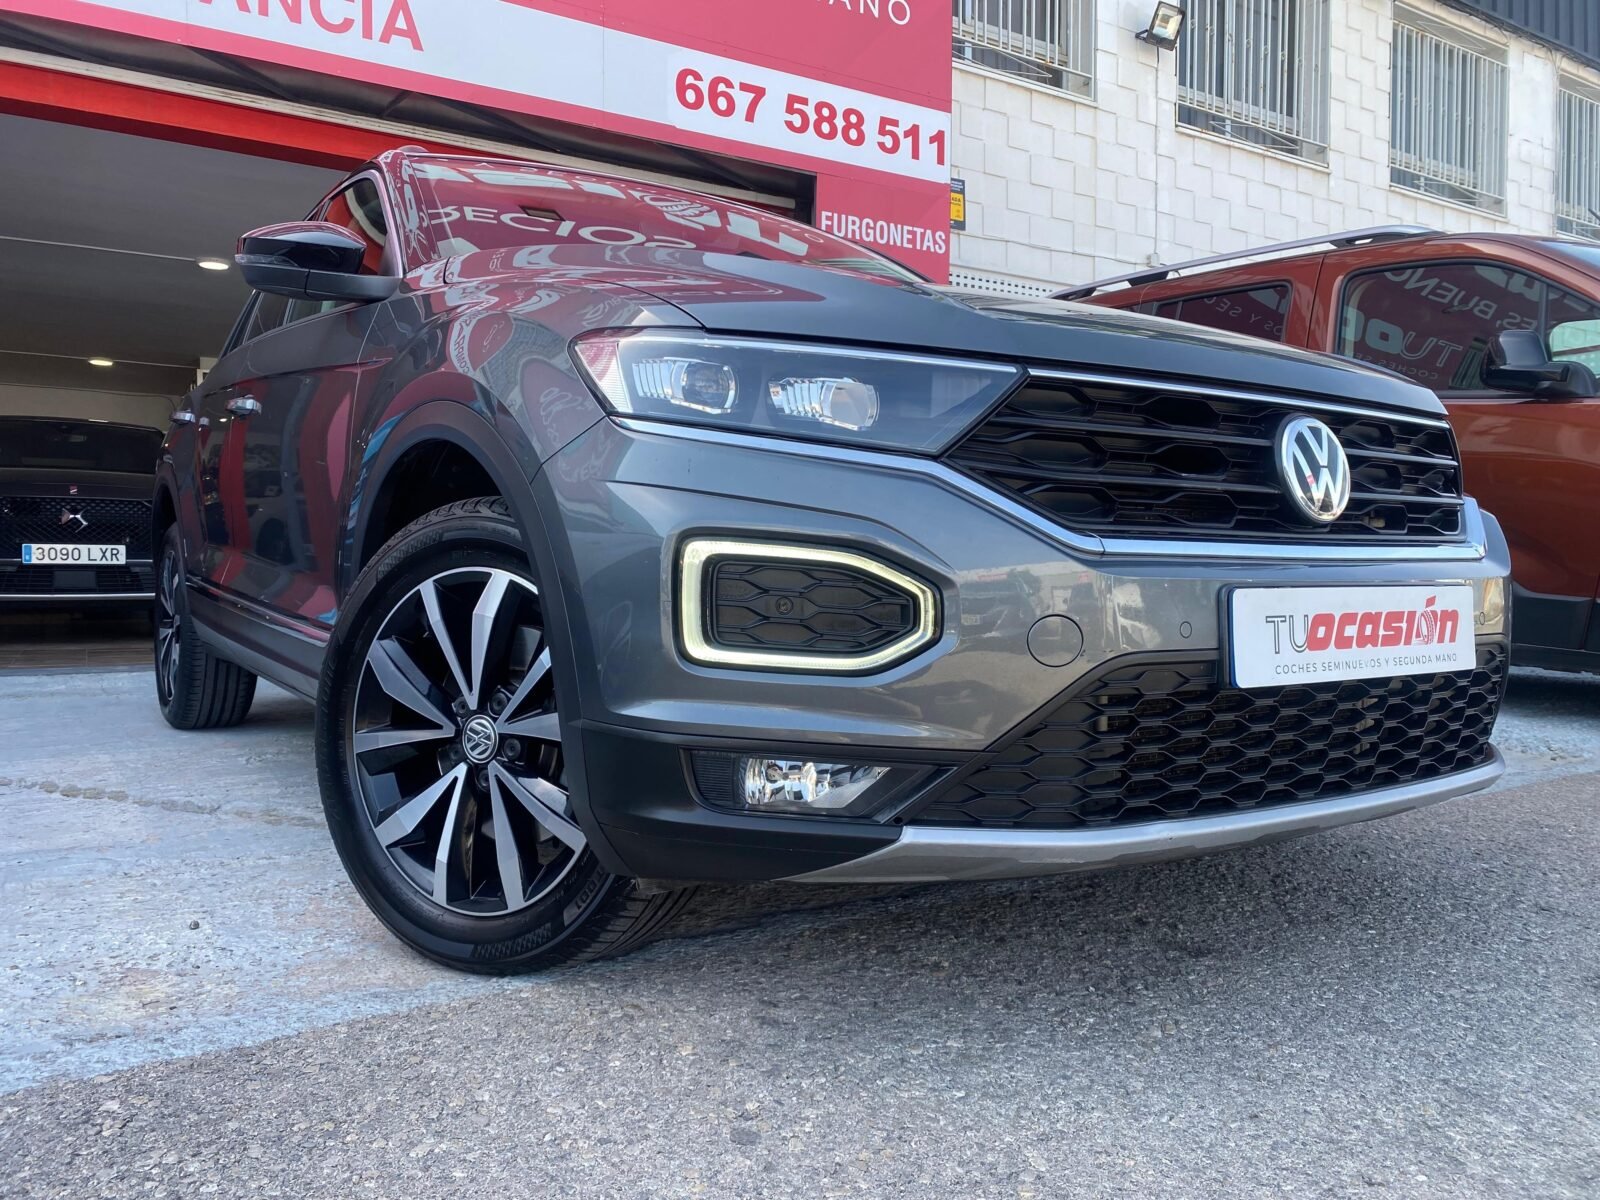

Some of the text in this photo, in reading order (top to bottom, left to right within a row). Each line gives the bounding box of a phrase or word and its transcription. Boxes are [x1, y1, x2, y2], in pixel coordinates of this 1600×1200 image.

[200, 0, 424, 51] CIA
[675, 68, 945, 166] 667 588 511
[820, 210, 946, 254] FURGONETAS
[35, 547, 120, 561] 3090 LXR
[1275, 653, 1457, 675] COCHES SEMINUEVOS Y SEGUNDA MANO
